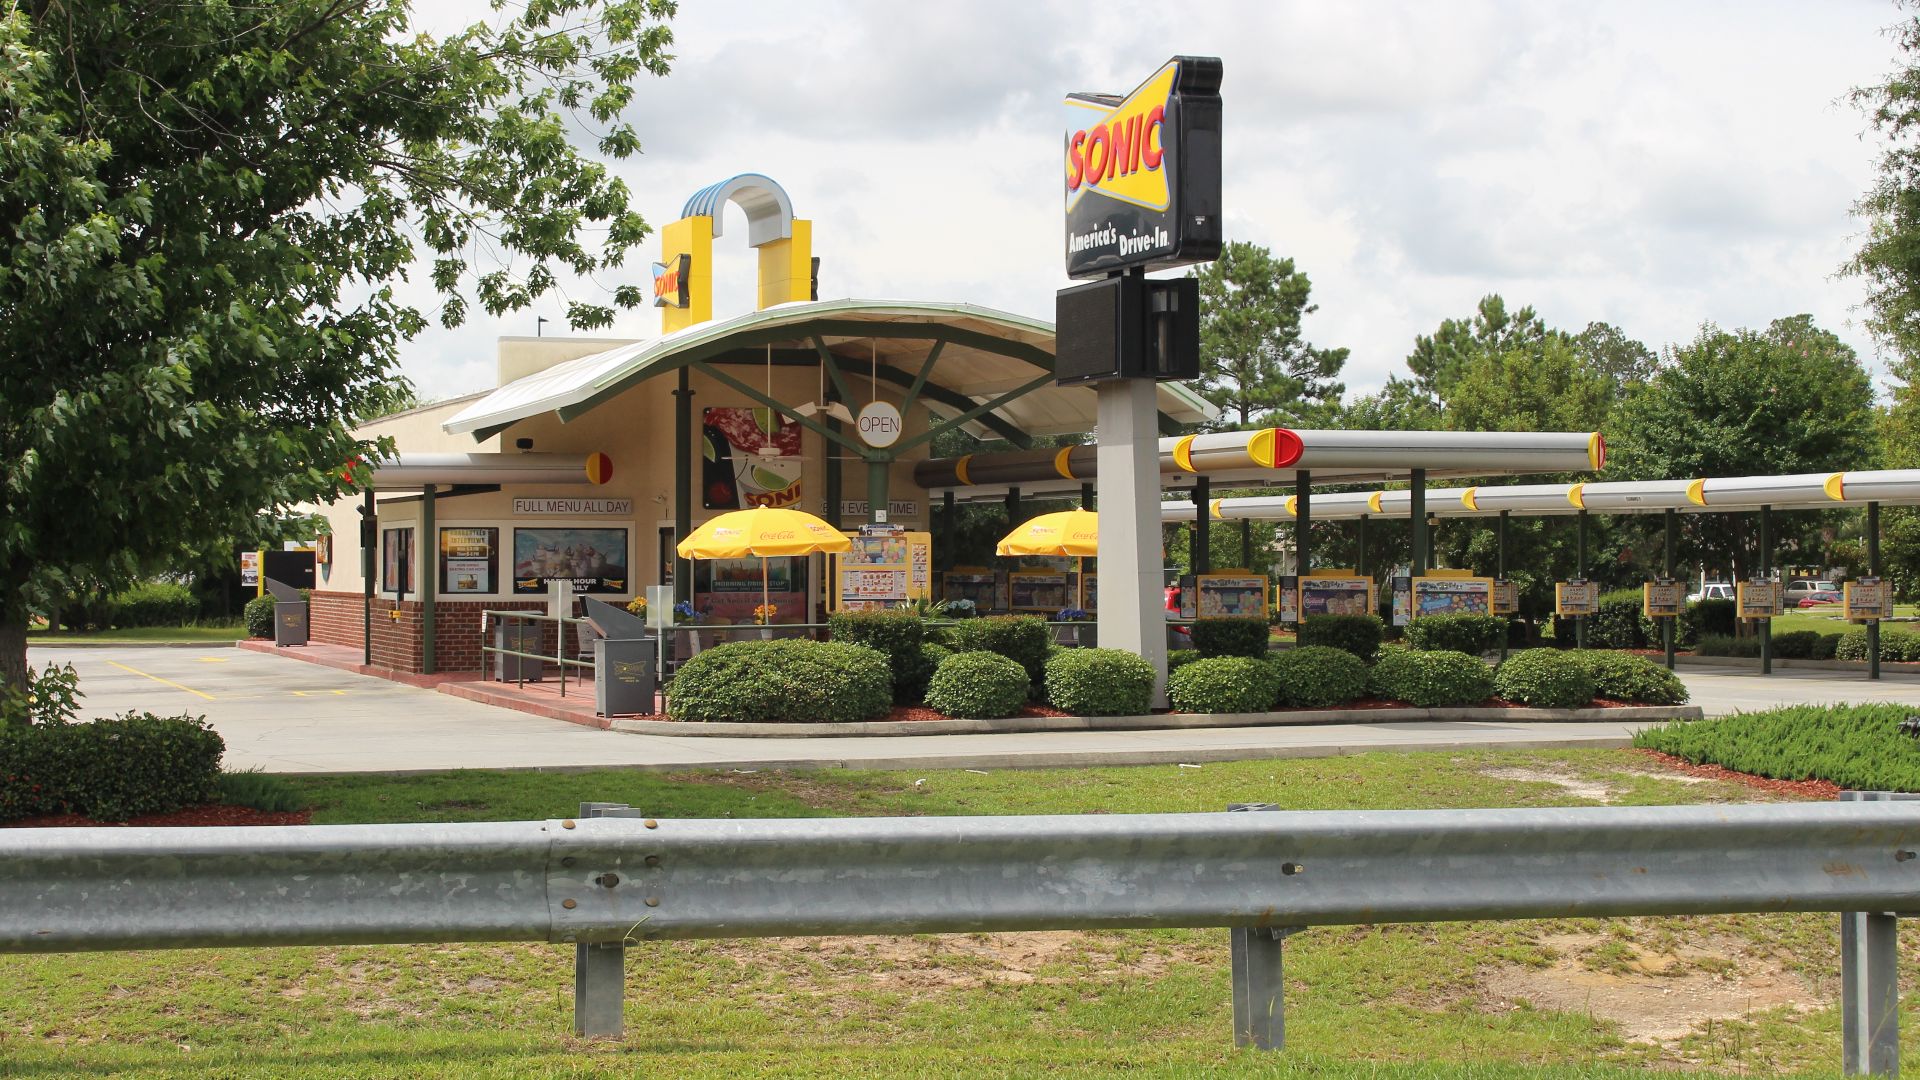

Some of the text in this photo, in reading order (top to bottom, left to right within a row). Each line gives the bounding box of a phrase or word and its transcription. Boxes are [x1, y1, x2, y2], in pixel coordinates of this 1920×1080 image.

[1069, 105, 1165, 192] SONIC
[1069, 222, 1117, 253] America's
[655, 271, 680, 297] SONIC
[859, 416, 899, 433] OPEN
[516, 501, 629, 512] FULL MENU ALL DAY
[848, 502, 868, 514] EVE
[888, 503, 916, 514] TIME!
